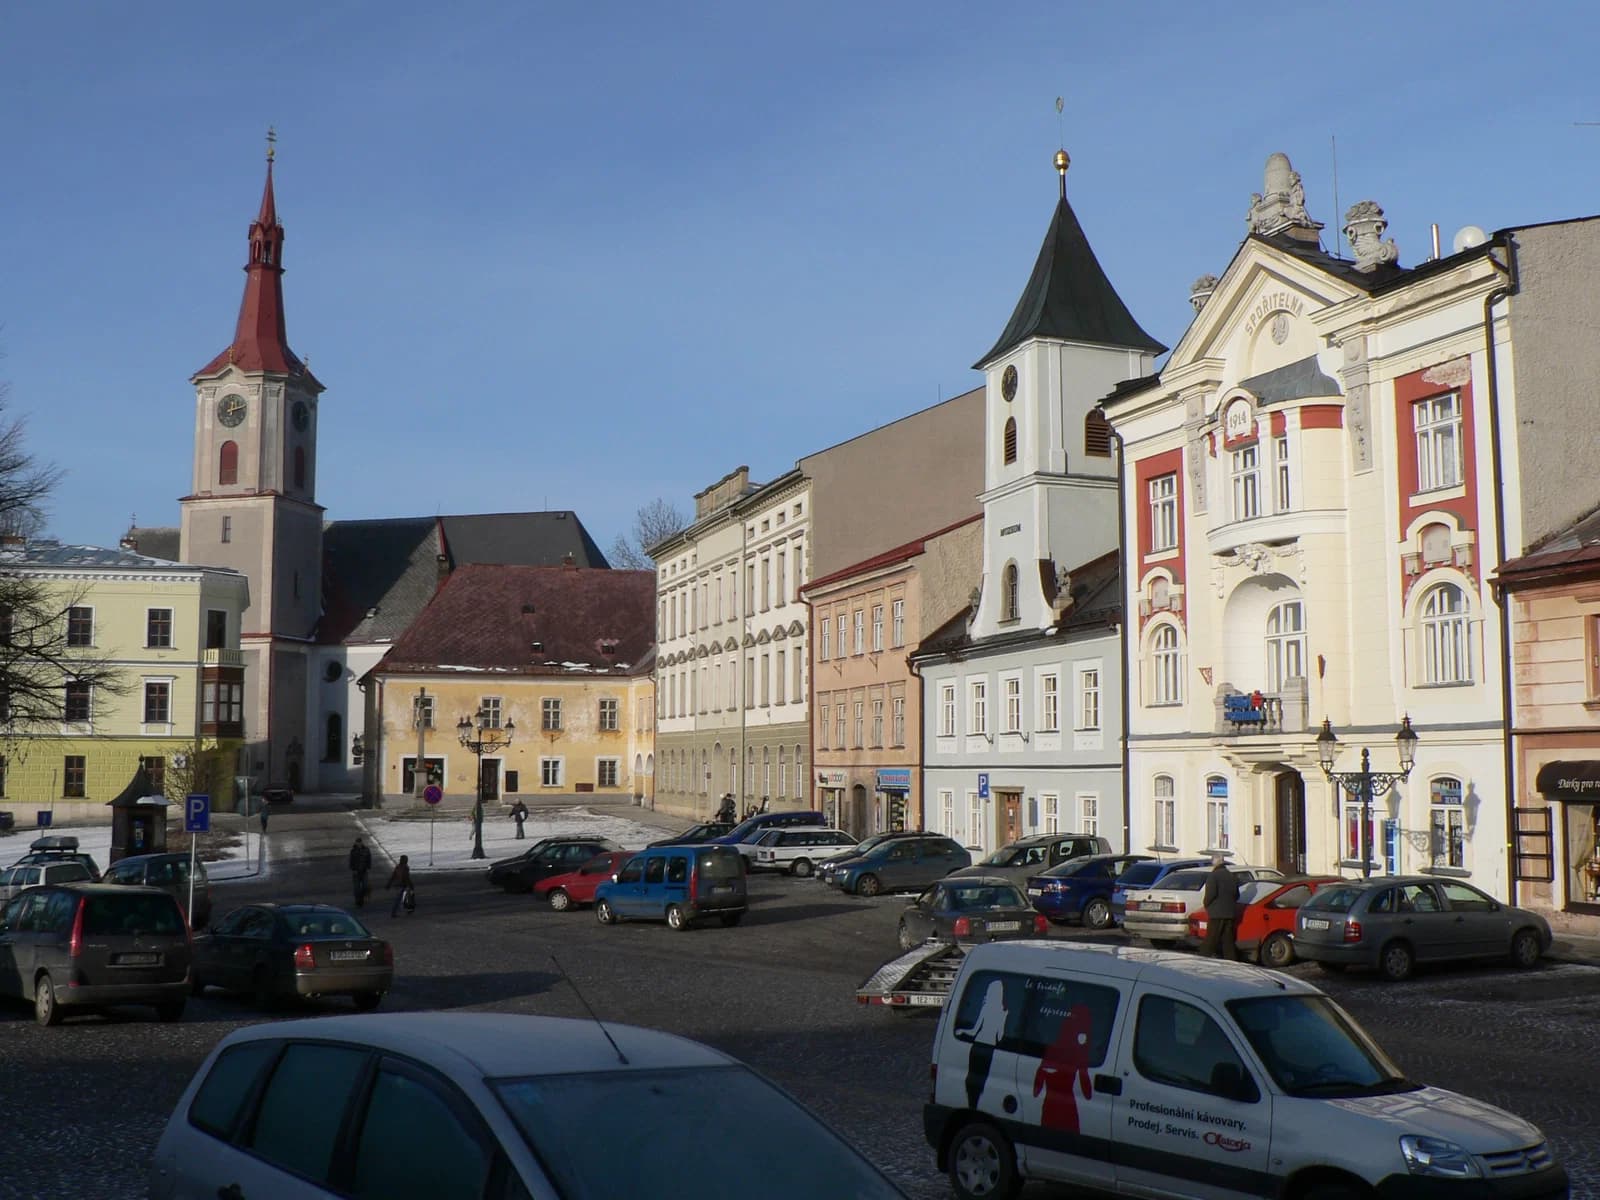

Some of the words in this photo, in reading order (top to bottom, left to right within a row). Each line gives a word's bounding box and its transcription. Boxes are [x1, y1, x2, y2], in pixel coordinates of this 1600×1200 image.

[1230, 410, 1247, 429] 1914
[980, 775, 987, 792] P
[1581, 780, 1594, 793] pro
[190, 799, 205, 821] P
[1127, 1116, 1162, 1134] Prodej.
[1165, 1124, 1200, 1140] Servis.
[1196, 1110, 1247, 1131] kávovary.
